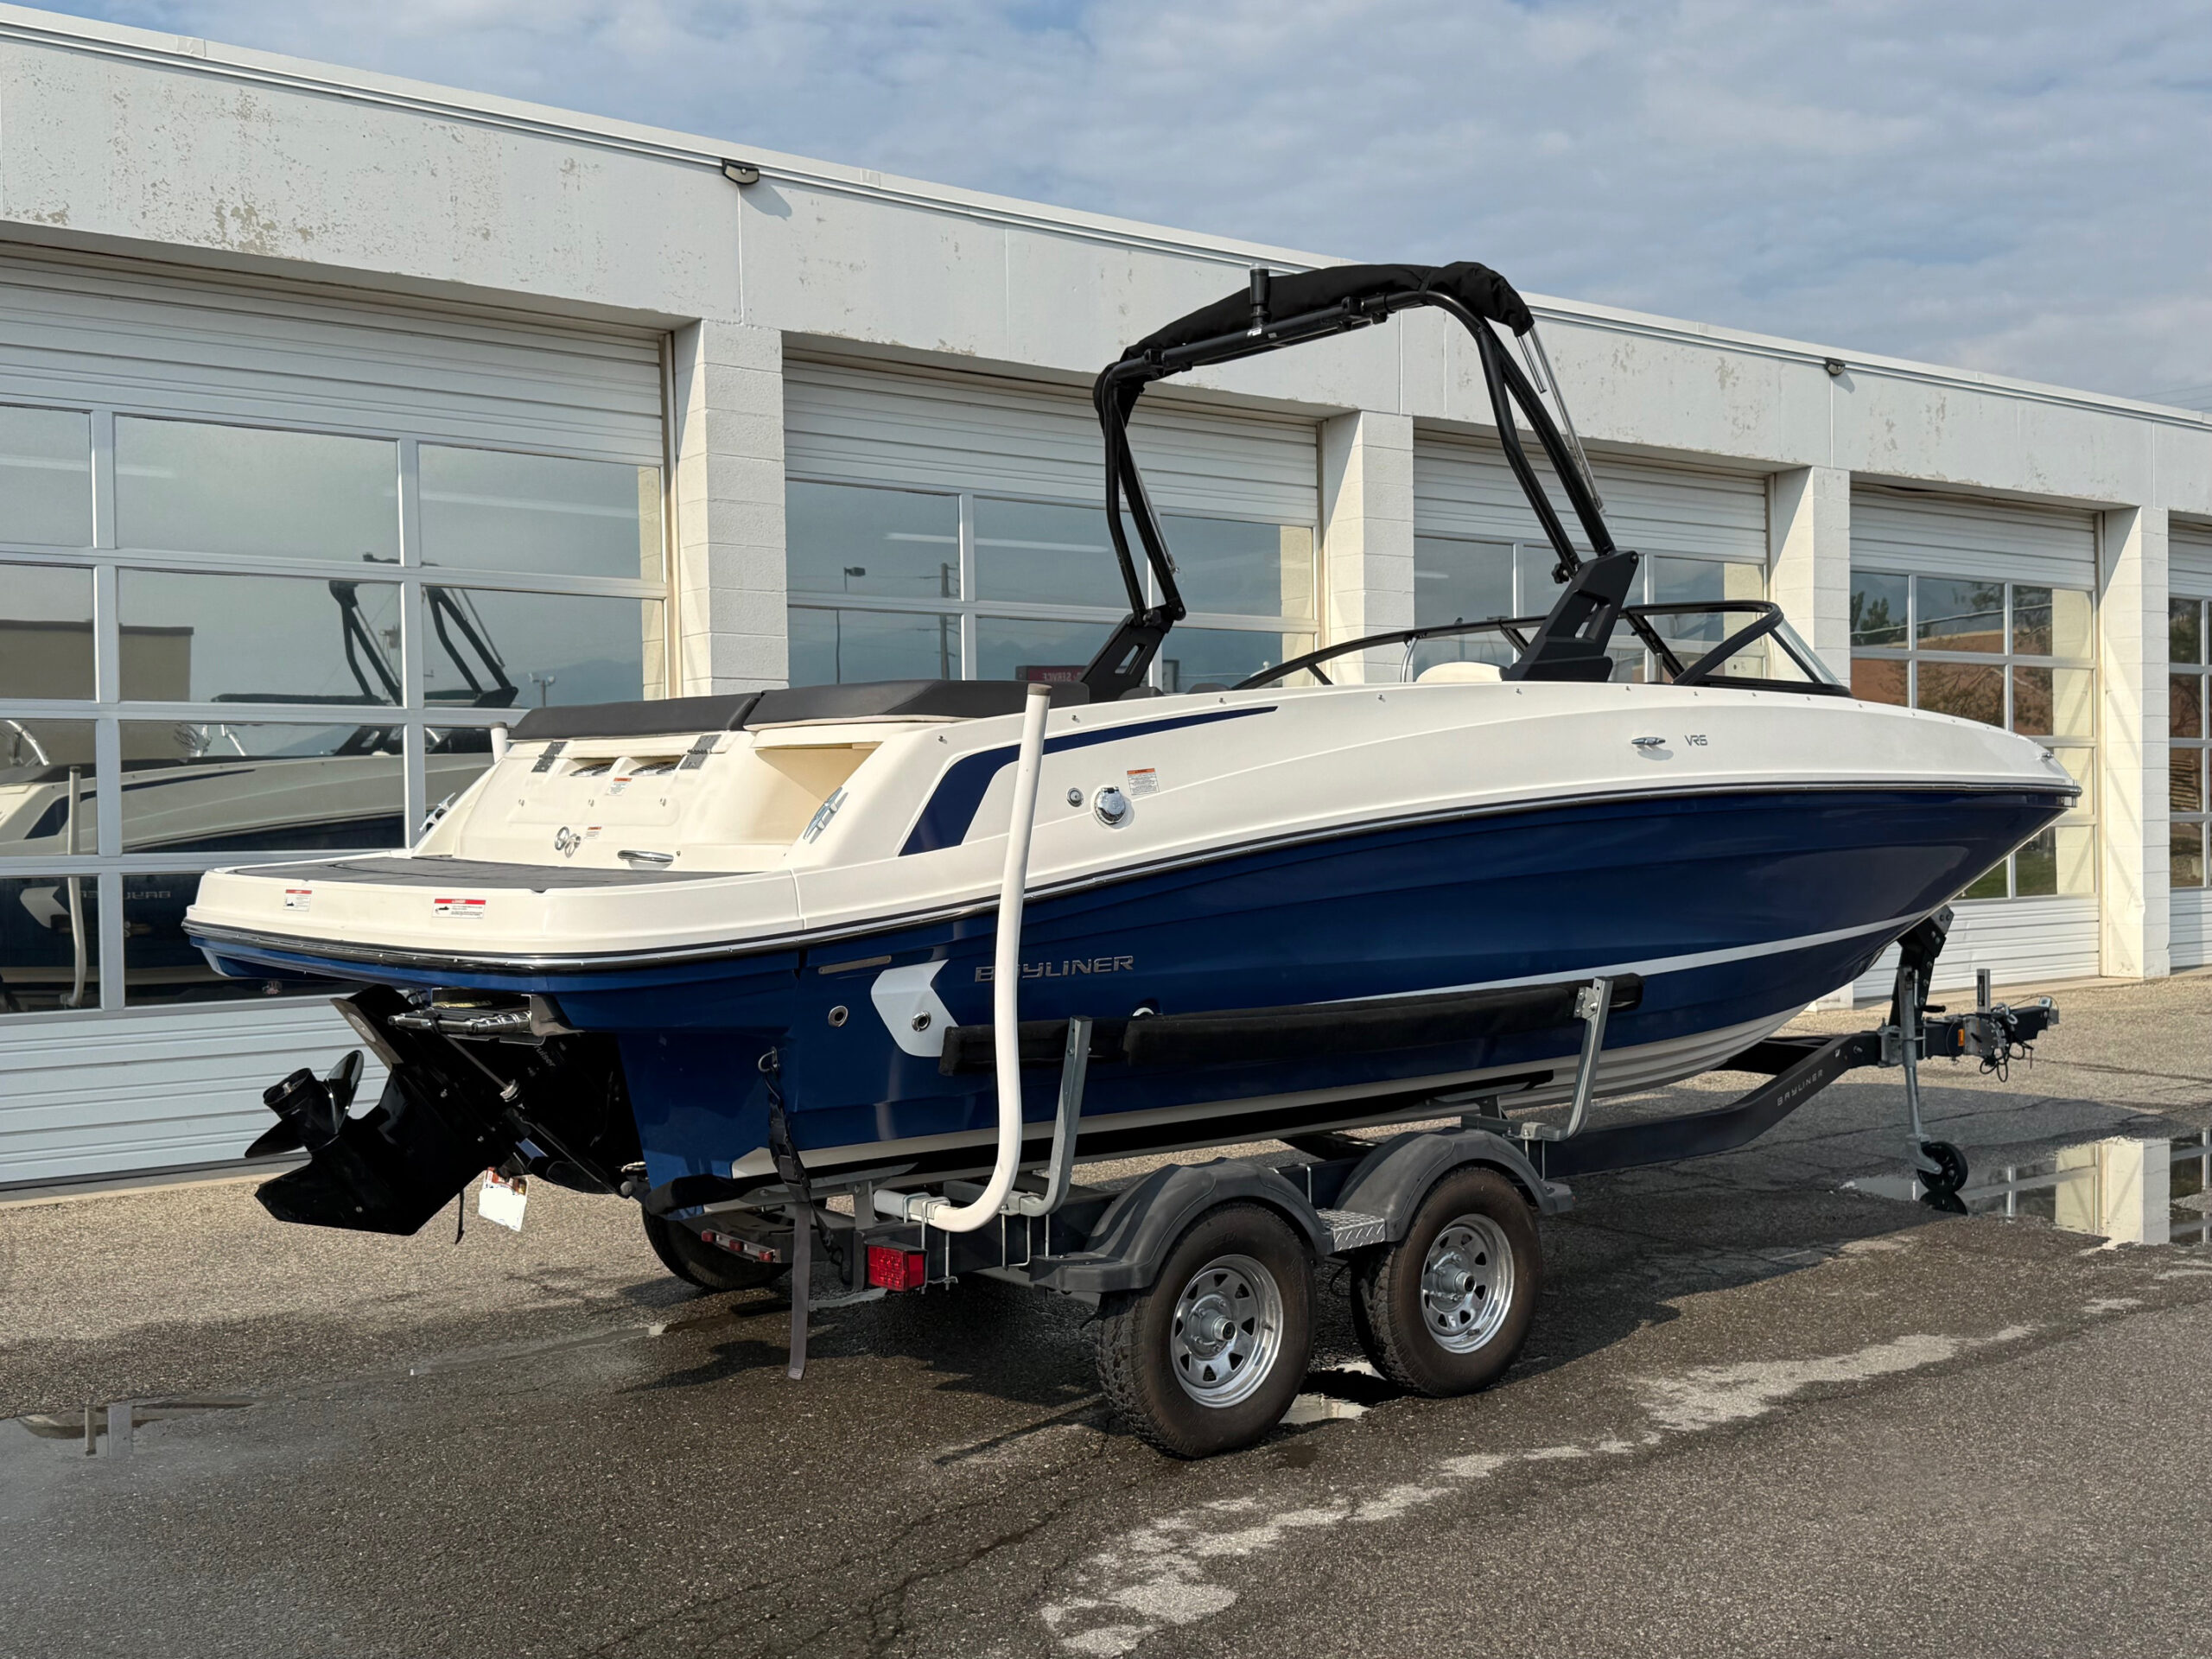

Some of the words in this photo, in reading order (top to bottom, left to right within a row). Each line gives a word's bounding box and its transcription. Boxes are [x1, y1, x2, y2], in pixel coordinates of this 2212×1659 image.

[1683, 734, 1708, 747] VR6
[975, 955, 1134, 982] BYLINER
[1777, 1069, 1823, 1107] BAYLINER
